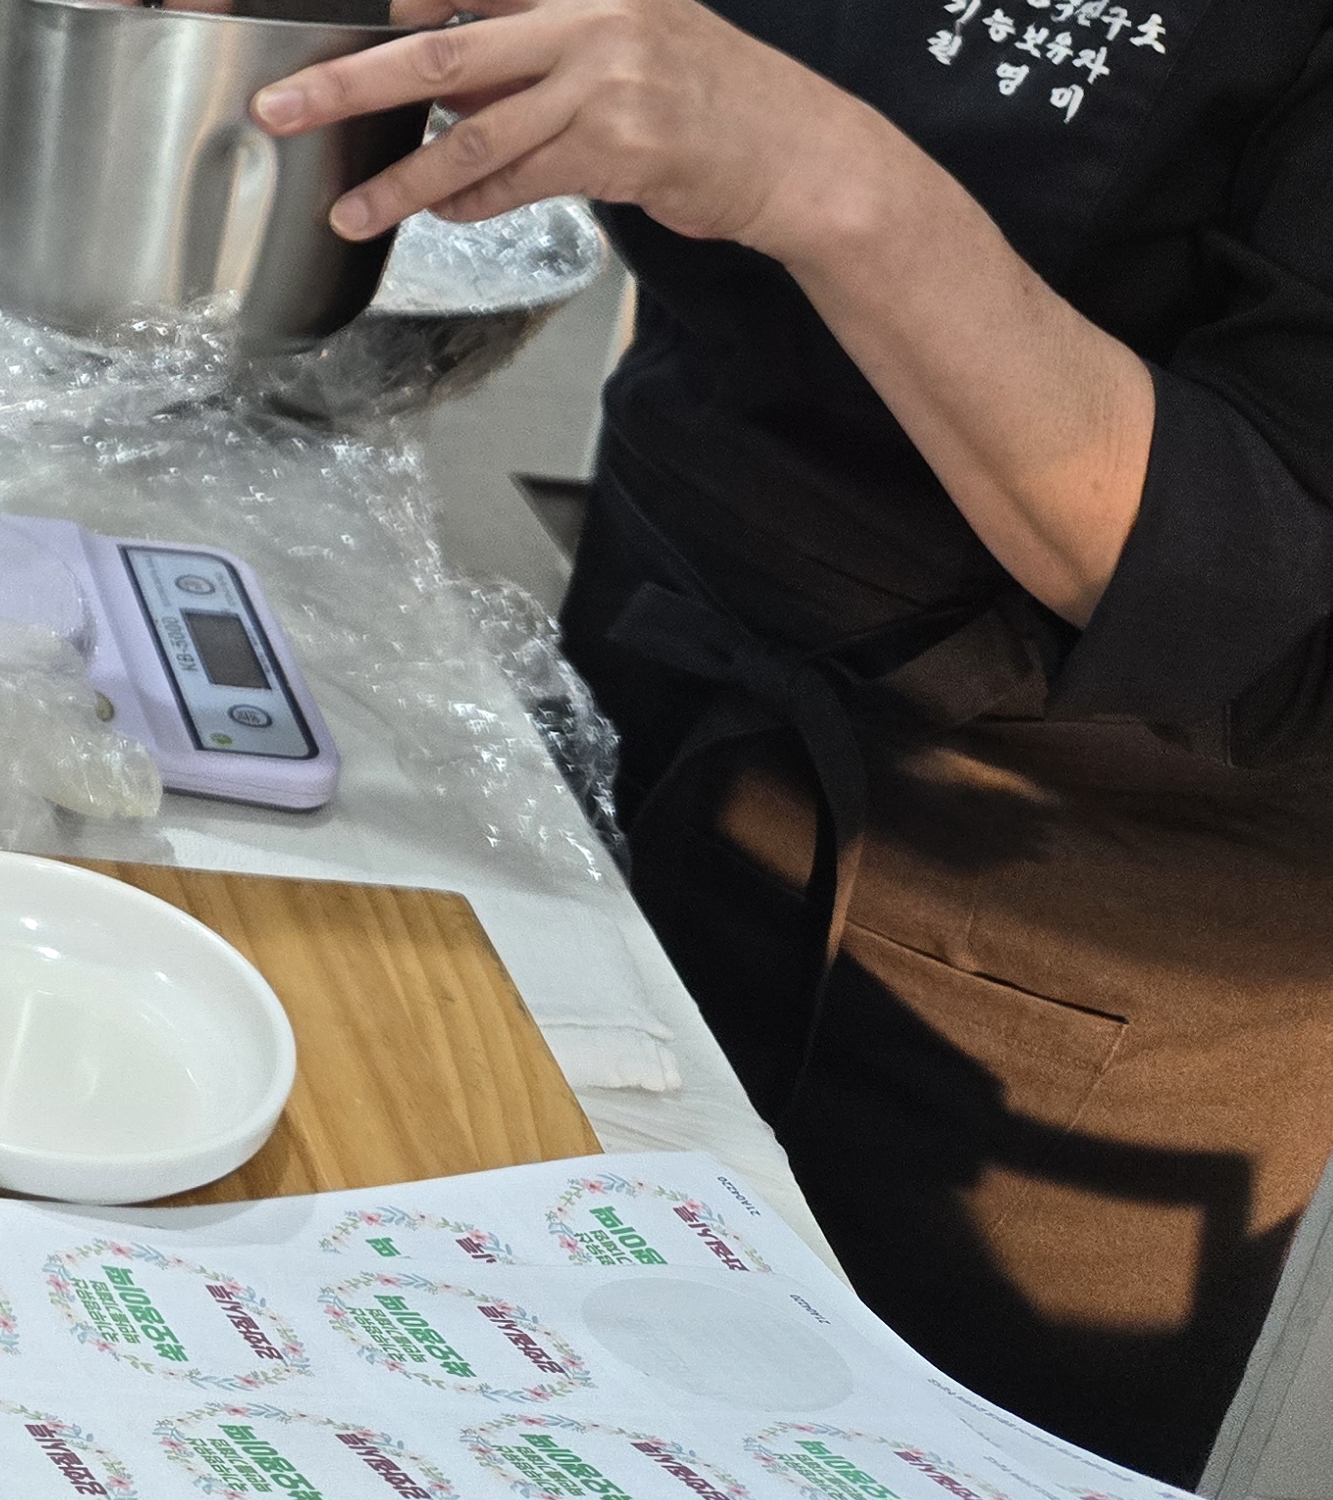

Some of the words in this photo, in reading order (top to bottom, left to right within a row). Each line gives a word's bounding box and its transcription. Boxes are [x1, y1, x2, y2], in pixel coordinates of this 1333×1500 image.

[589, 1205, 669, 1265] 쟁이떡
[72, 1277, 120, 1343] 국가무형유산
[101, 1265, 189, 1362] 쑥오쟁이떡
[205, 1284, 284, 1361] 강화질시루
[374, 1294, 477, 1378] 쑥오쟁이떡
[477, 1304, 565, 1374] 강화질시루
[24, 1424, 109, 1496] 강화질시루
